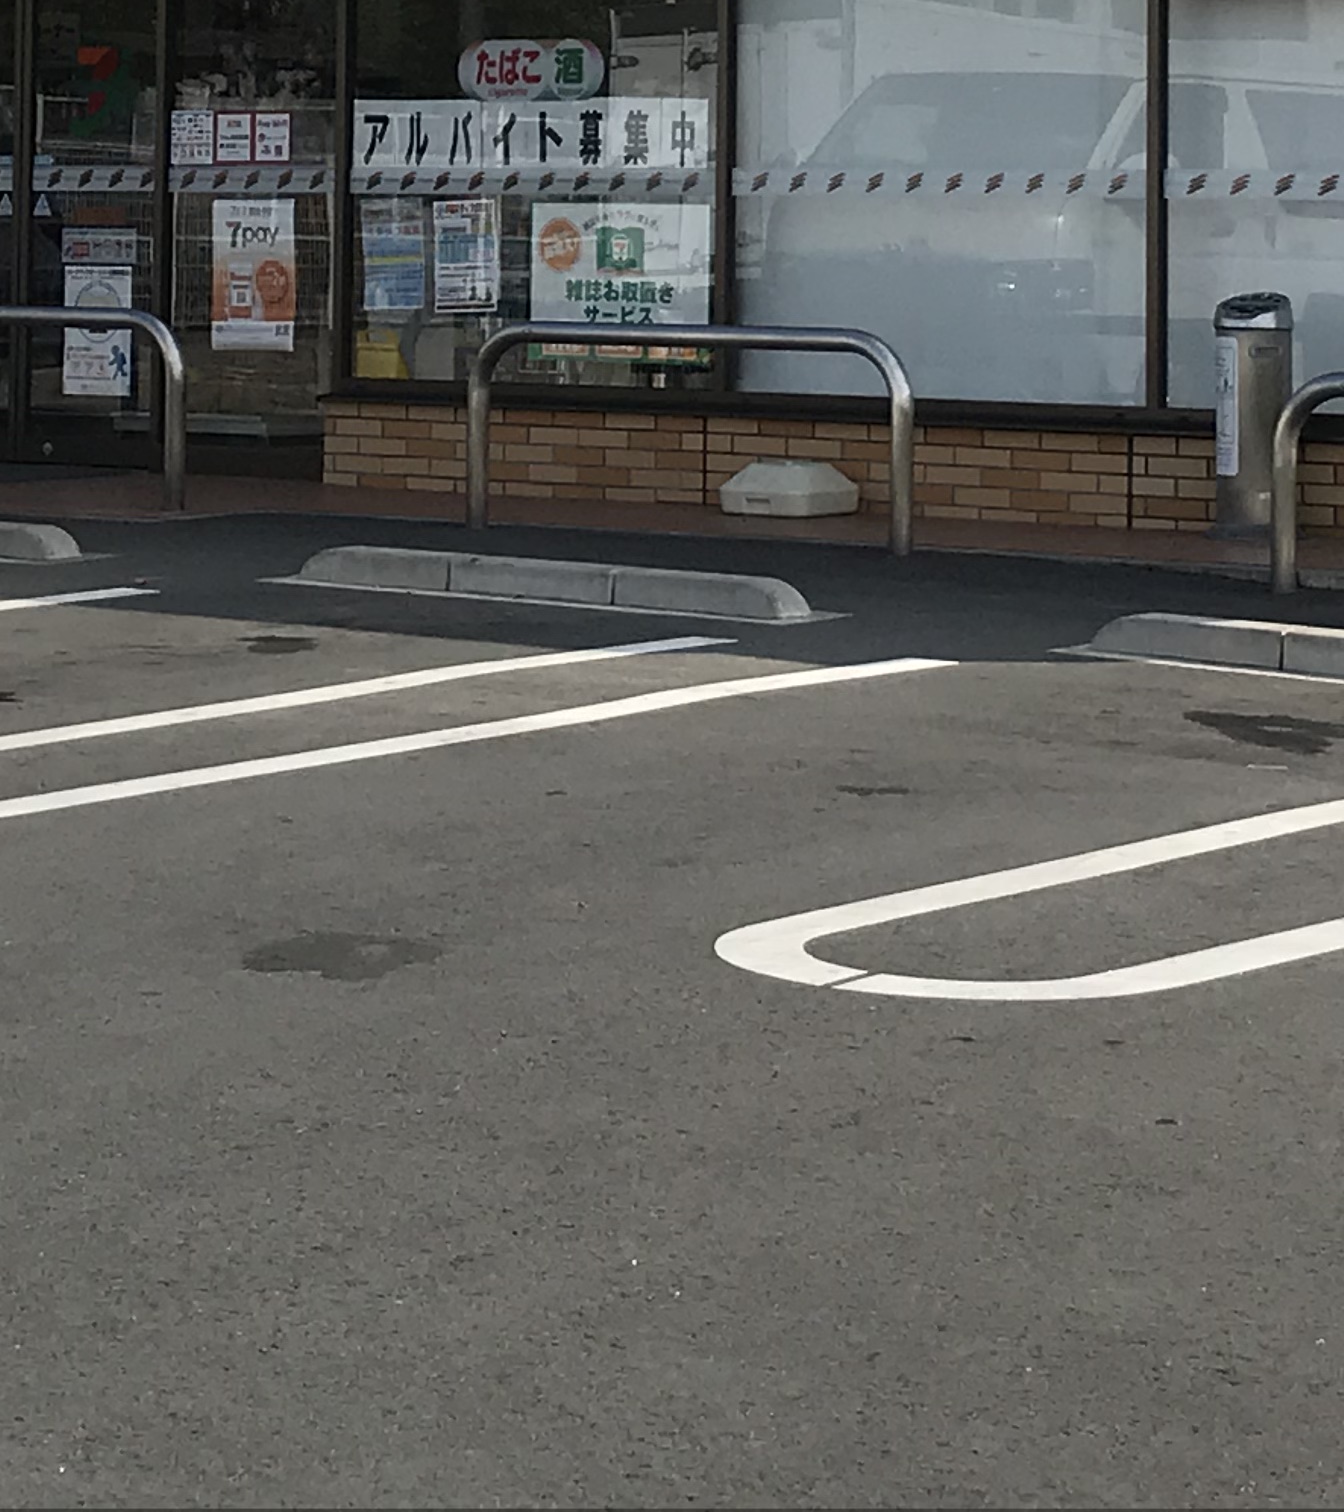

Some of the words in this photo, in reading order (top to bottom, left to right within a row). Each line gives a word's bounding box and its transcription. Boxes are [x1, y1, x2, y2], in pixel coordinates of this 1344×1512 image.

[476, 47, 542, 85] たばこ
[554, 47, 585, 84] 酒
[363, 109, 697, 168] アルバイト募集中
[225, 220, 280, 248] 7pay
[583, 305, 655, 324] サービス
